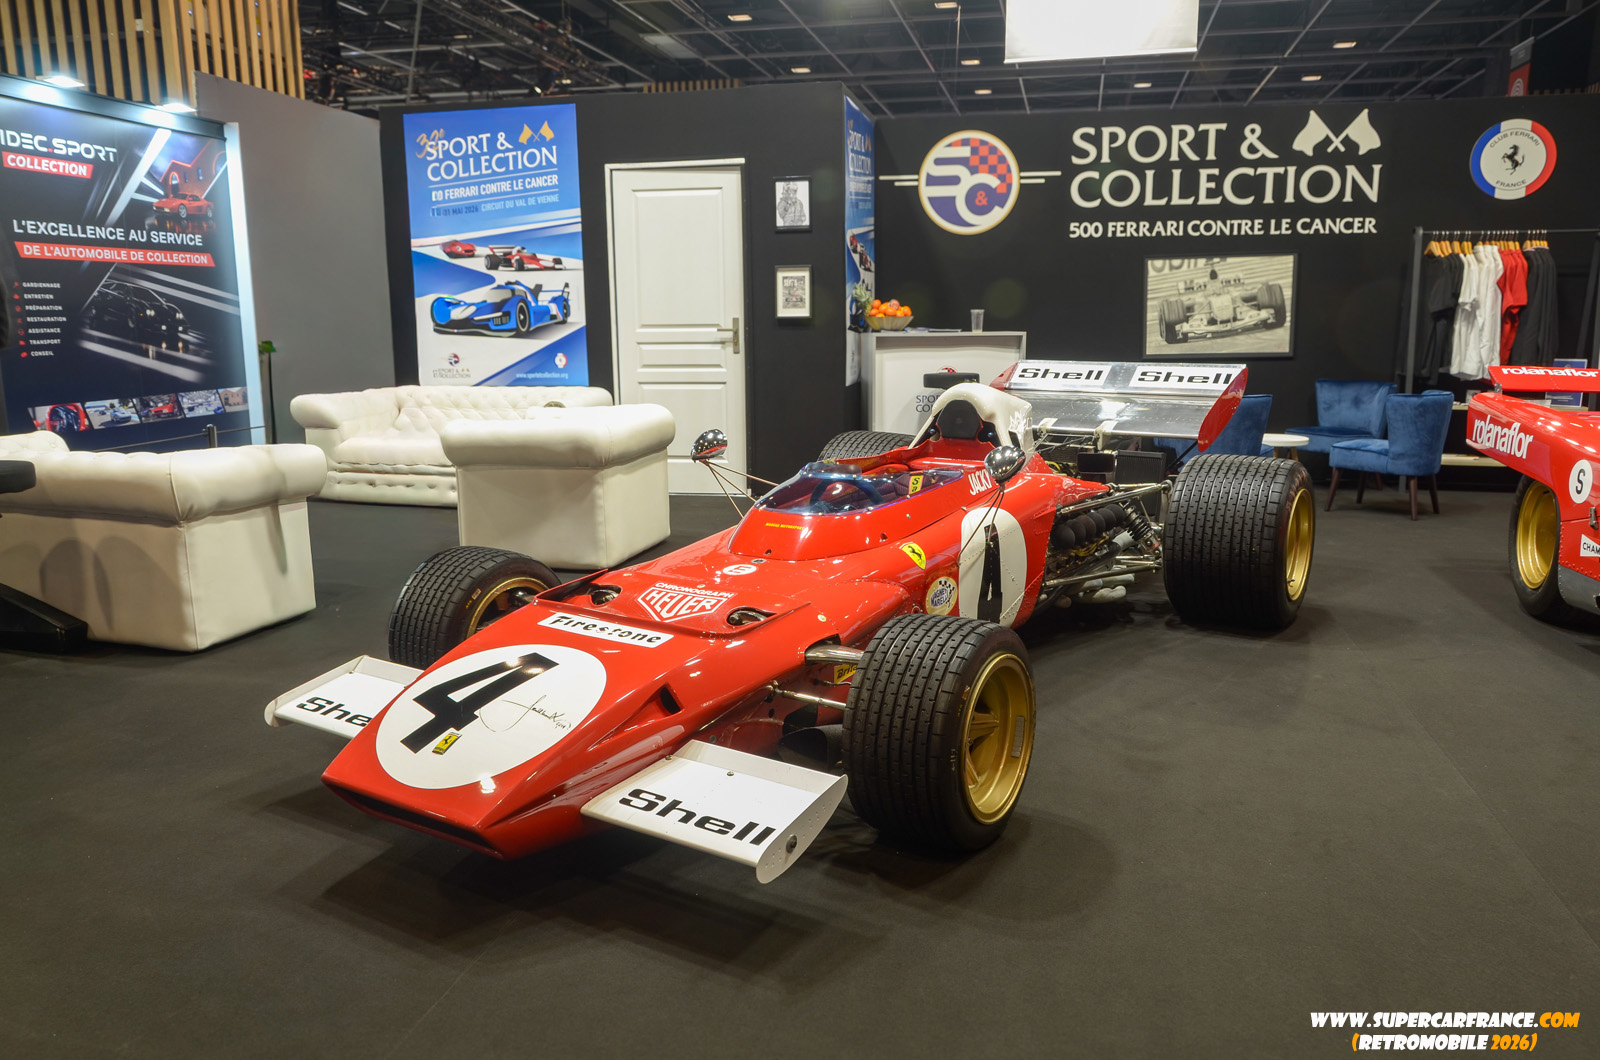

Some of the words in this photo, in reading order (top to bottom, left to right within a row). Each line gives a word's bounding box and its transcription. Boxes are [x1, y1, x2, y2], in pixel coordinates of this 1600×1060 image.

[426, 133, 491, 161] SPORT
[497, 131, 513, 150] &
[1071, 123, 1227, 165] SPORT
[1240, 123, 1279, 160] &
[1490, 133, 1508, 148] CLUB
[1510, 131, 1540, 146] FERRARI
[7, 154, 87, 176] COLLECTION
[427, 146, 558, 182] COLLECTION
[445, 185, 479, 200] FERRARI
[480, 180, 512, 195] CONTRE
[513, 178, 524, 191] LE
[525, 174, 559, 188] CANCER
[1070, 164, 1382, 208] COLLECTION
[1495, 179, 1527, 188] FRANCE
[481, 201, 504, 212] CIRCUIT
[505, 200, 514, 209] DU
[515, 197, 527, 208] VAL
[528, 196, 536, 206] DE
[537, 193, 560, 205] VIENNE
[13, 219, 125, 240] L'EXCELLENCE
[129, 229, 147, 242] AU
[150, 231, 203, 246] SERVICE
[1069, 221, 1103, 238] 500
[1107, 220, 1184, 238] FERRARI
[1187, 219, 1264, 236] CONTRE
[1270, 218, 1291, 235] LE
[1296, 217, 1377, 235] CANCER
[23, 244, 41, 256] DE
[44, 246, 127, 260] L'AUTOMOBILE
[130, 251, 144, 261] DE
[147, 252, 208, 264] COLLECTION
[1019, 367, 1104, 381] Shell
[1138, 371, 1232, 385] Shell
[1501, 366, 1599, 378] rolanaflor
[1472, 414, 1534, 459] rolanaflor
[1575, 468, 1586, 495] S
[654, 582, 735, 598] CHRONOGRAPH
[645, 590, 718, 619] HEUER
[550, 615, 662, 644] Firestone
[399, 652, 560, 754] 4
[618, 788, 777, 846] Shell
